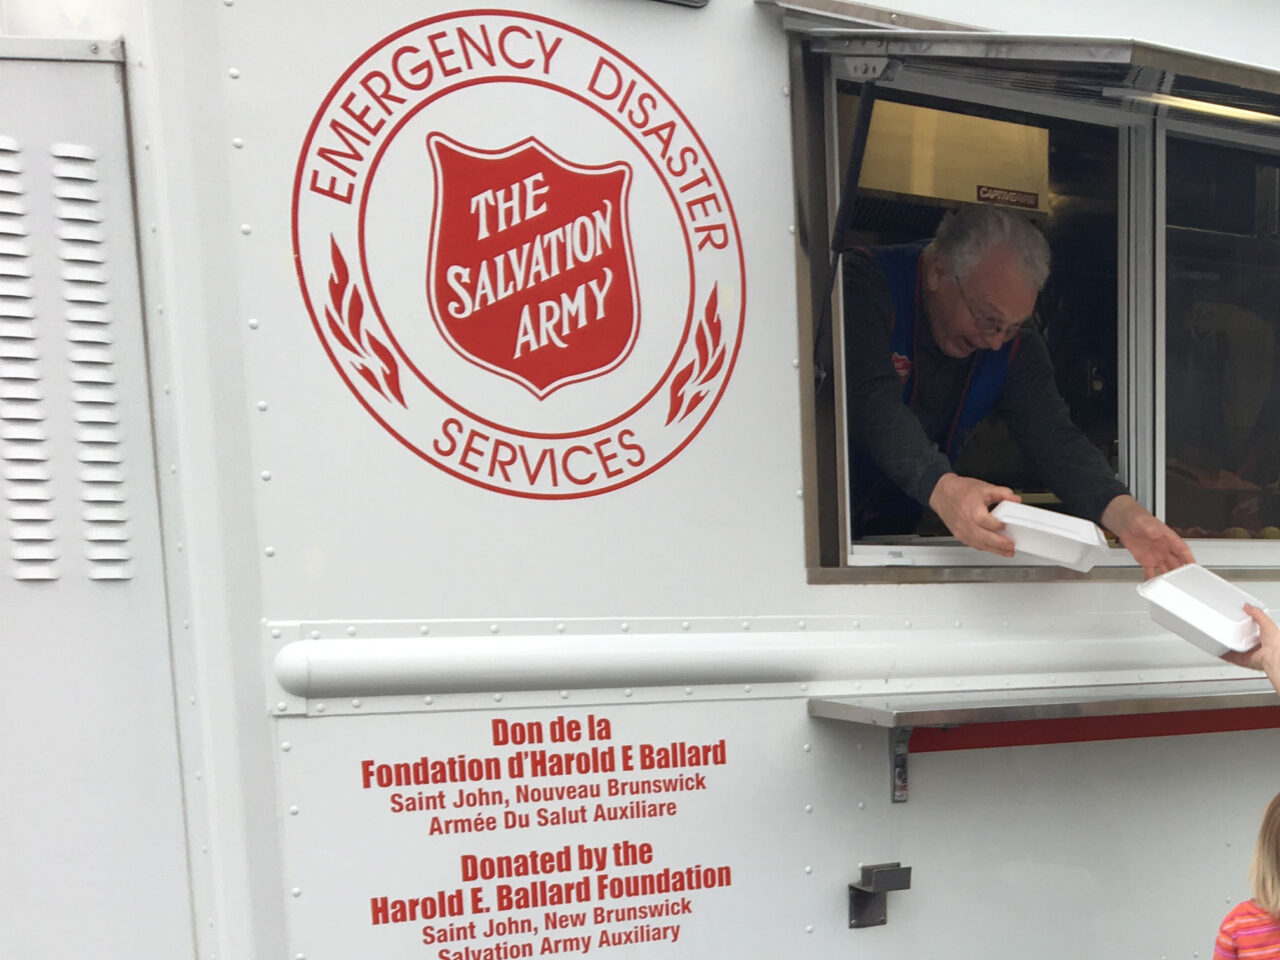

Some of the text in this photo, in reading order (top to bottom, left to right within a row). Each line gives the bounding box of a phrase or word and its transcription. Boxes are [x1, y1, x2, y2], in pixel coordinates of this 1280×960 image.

[309, 24, 729, 252] EMERGENCY DISASTER
[470, 172, 550, 241] THE
[446, 199, 613, 319] SALVATION
[512, 267, 613, 359] ARMY
[433, 417, 645, 487] SERVICES
[492, 714, 612, 746] Don de la
[361, 740, 727, 788] Fondation d'Harold E Ballard
[390, 773, 707, 813] Saint John, Nouveau Brunswick
[429, 801, 677, 836] Armée Du Salut Auxiliare
[460, 840, 653, 882] Donated by the
[370, 864, 732, 925] Harold E. Ballard Foundation
[422, 897, 692, 945] Saint John, New Brunswick
[540, 934, 592, 957] Army
[599, 923, 681, 948] Auxiliary
